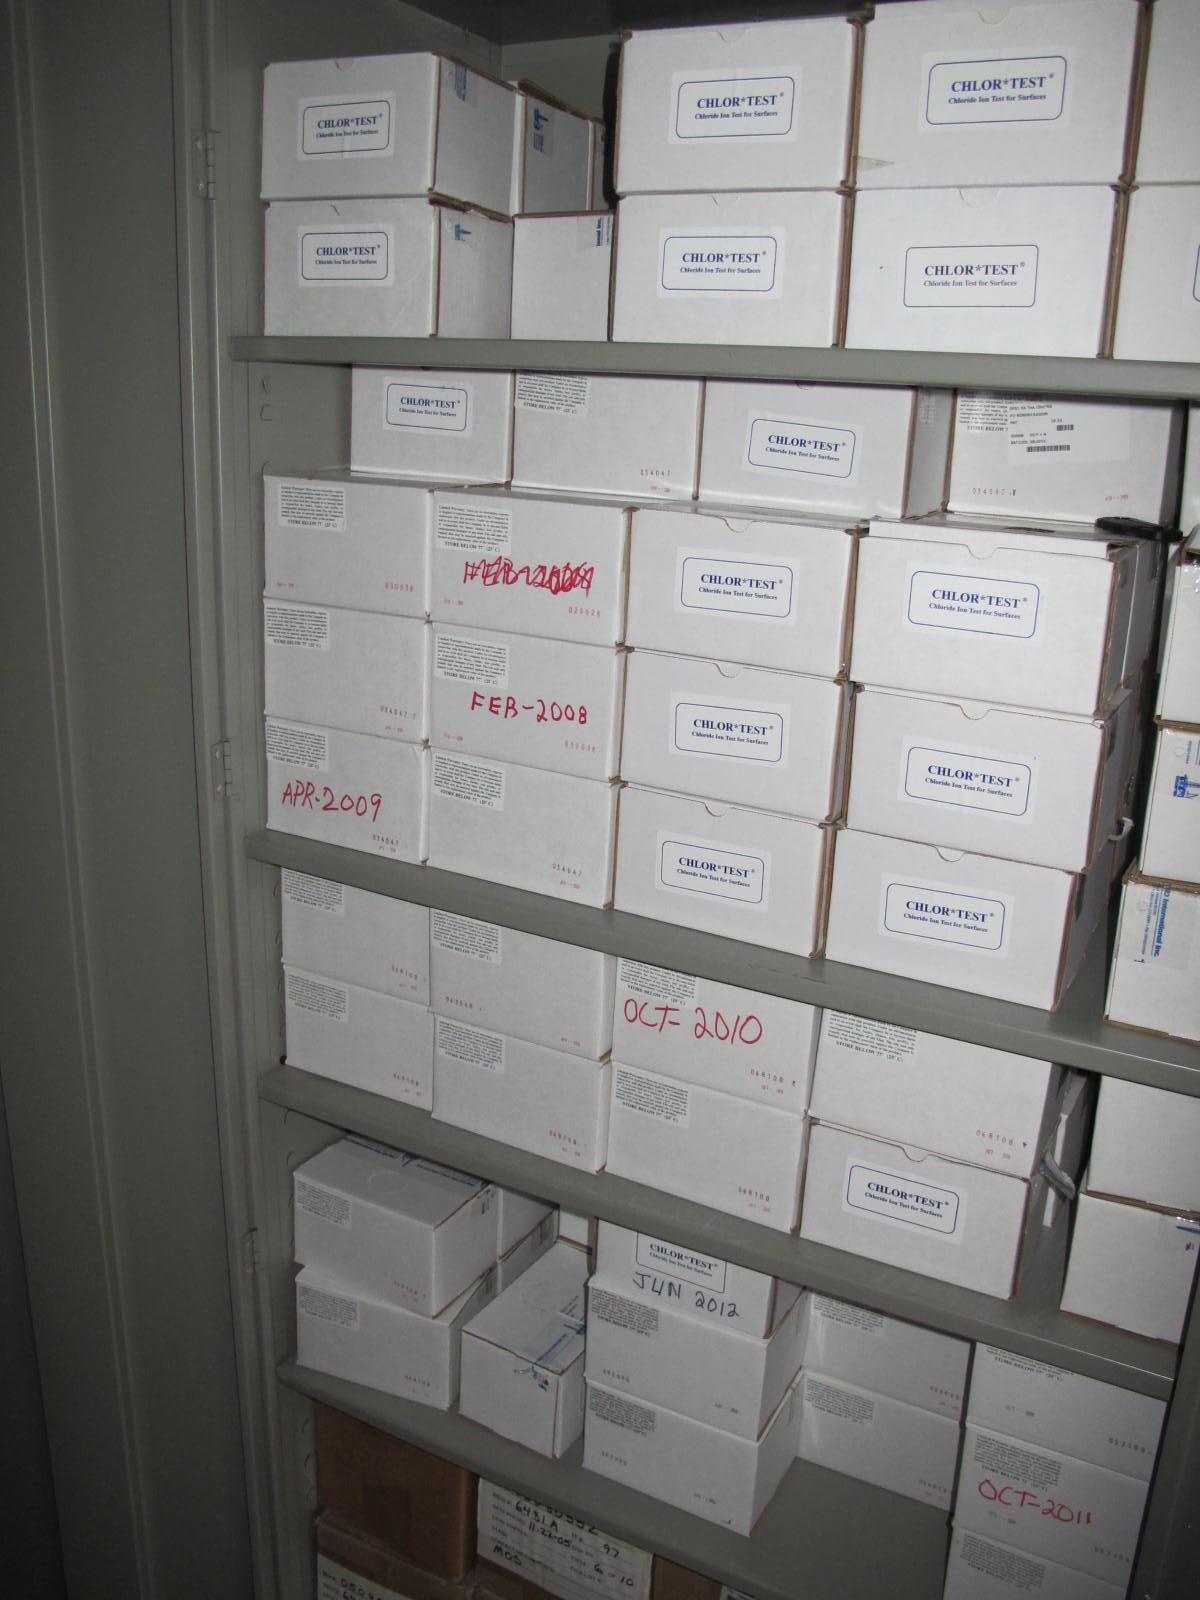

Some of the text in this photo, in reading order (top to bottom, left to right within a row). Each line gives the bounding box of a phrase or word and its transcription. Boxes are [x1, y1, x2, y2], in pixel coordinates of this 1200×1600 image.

[948, 93, 1046, 105] Chloride Ion Test for Surfaces
[698, 586, 722, 595] Chloride
[754, 592, 778, 600] Surfaces
[929, 602, 1021, 620] Chloride Ion Test for Surfaces
[471, 690, 587, 724] FEB-2008
[282, 780, 382, 822] APR-2009
[924, 777, 1013, 798] Chloride Ion Test for Surfaces
[903, 912, 988, 933] Chloride Ion Test for Surfaces
[694, 1007, 763, 1045] 2010
[633, 1271, 740, 1317] JUN 2012
[978, 1484, 1091, 1524] OCT-2011
